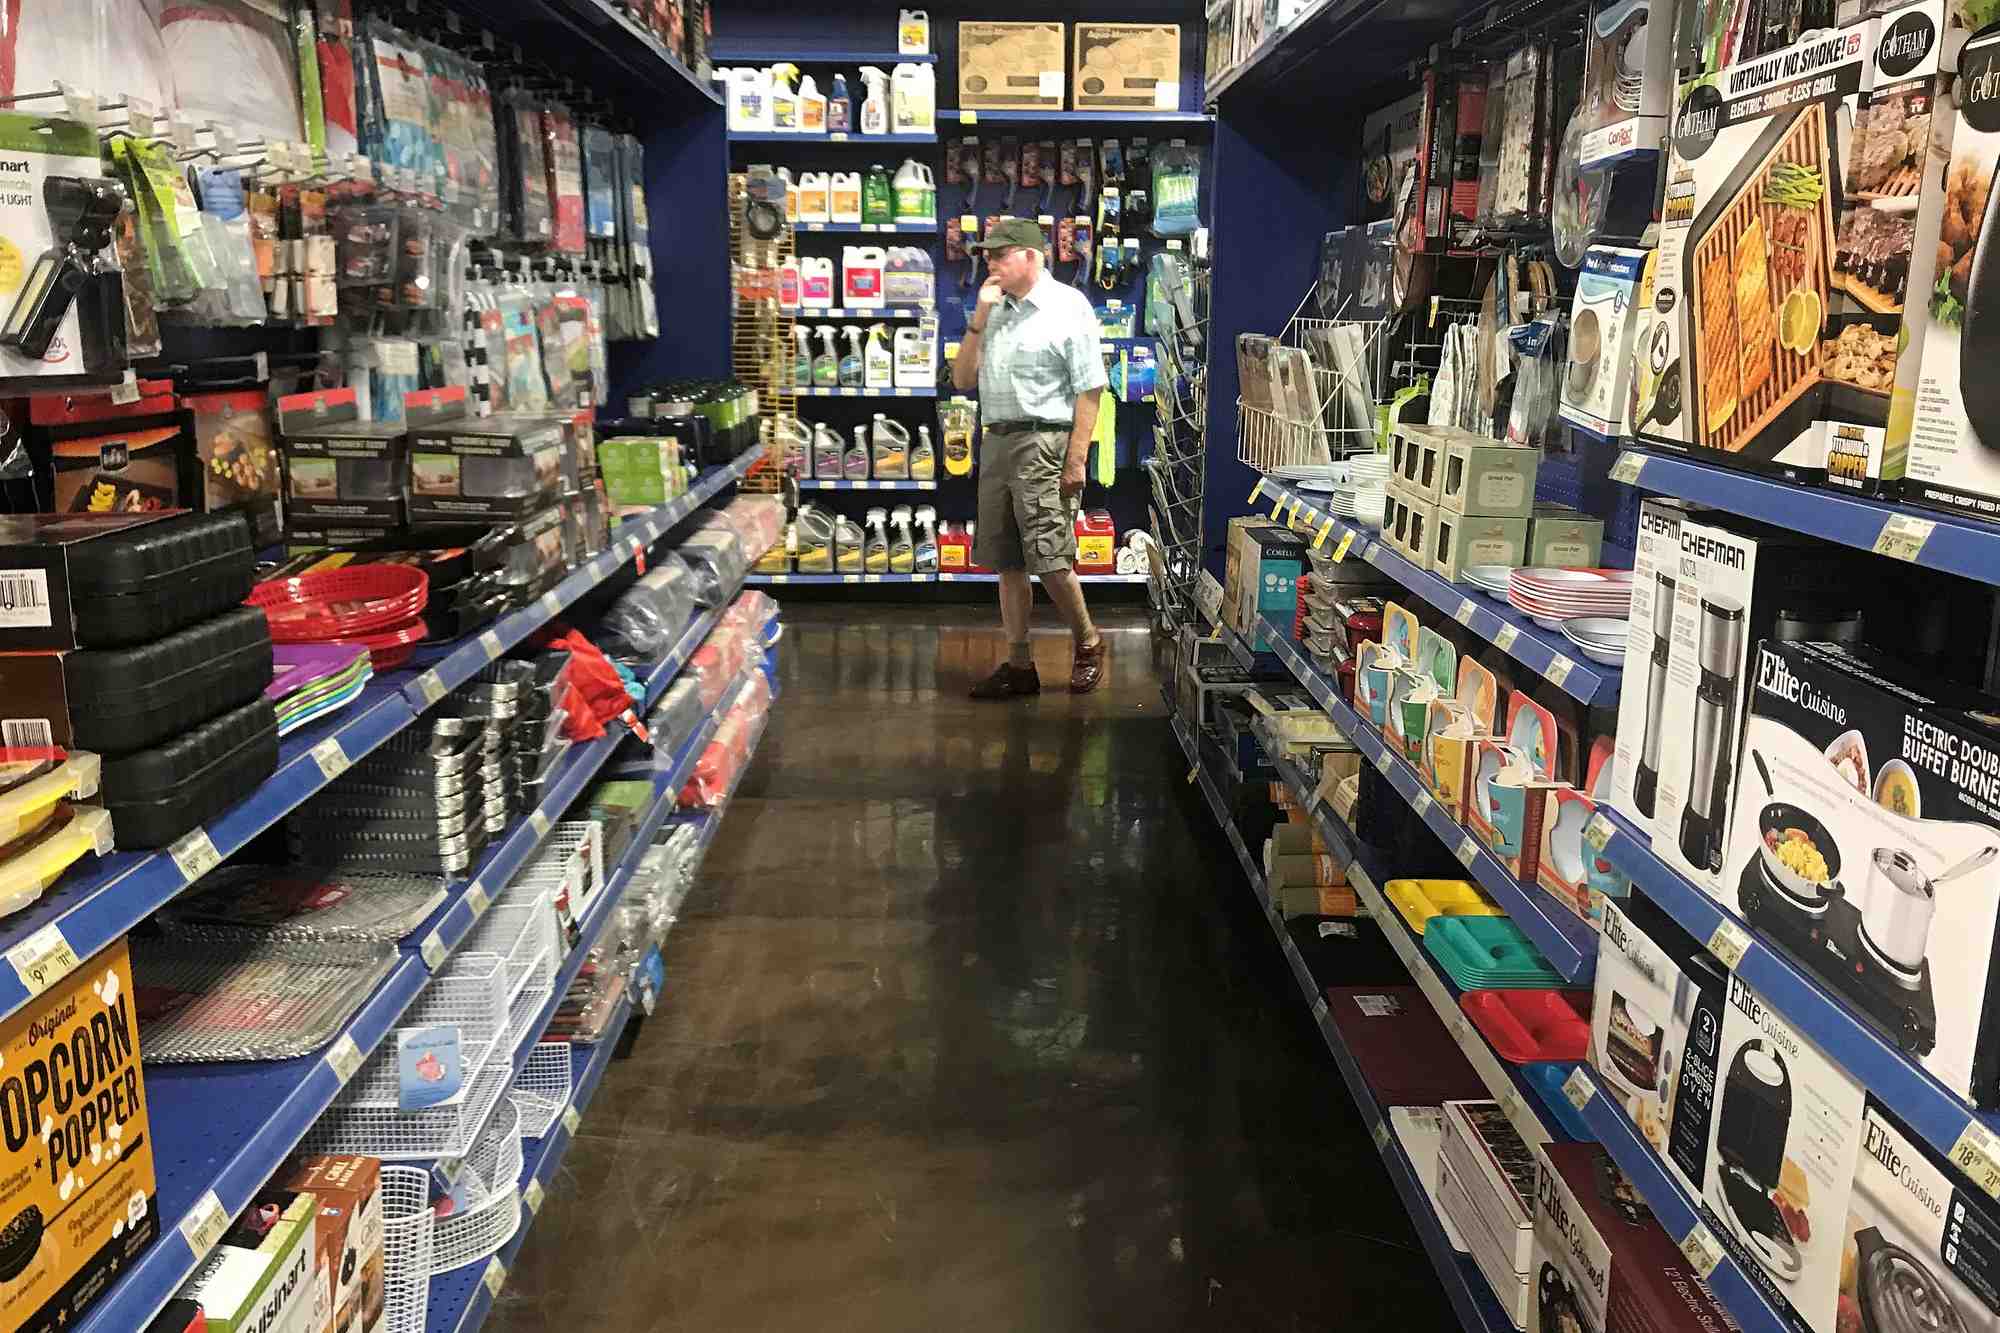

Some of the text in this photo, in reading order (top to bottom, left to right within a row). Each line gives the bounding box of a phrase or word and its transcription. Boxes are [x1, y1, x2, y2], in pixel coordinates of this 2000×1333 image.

[1730, 35, 1847, 94] VIRTUALLY NO SMOKE!
[1882, 28, 1928, 59] GOTHAM
[1678, 104, 1720, 139] GOTHAM
[1730, 97, 1763, 119] ELECTRIC
[1812, 74, 1837, 100] GRILL
[1641, 512, 1680, 540] CHEFM
[1681, 531, 1745, 571] CHEFMAN
[1757, 649, 1800, 703] Elite
[1800, 681, 1847, 726] Cuisine
[1902, 735, 2000, 807] BUFFET BURNE
[1904, 714, 2000, 779] ELECTRIC DOUB
[1603, 904, 1656, 983] Elite Cuisine
[29, 996, 77, 1046] Original
[1702, 1016, 1710, 1032] 2
[1729, 974, 1800, 1058] Elite Cuisine
[1, 993, 132, 1152] OPCORN
[1685, 1060, 1713, 1097] TOASTER
[1686, 1048, 1714, 1083] 2-SLICE
[49, 1065, 139, 1185] POPPER
[1863, 1119, 1942, 1218] Elite Cuisine
[1538, 1161, 1569, 1239] Elite
[246, 1248, 306, 1333] uisinart
